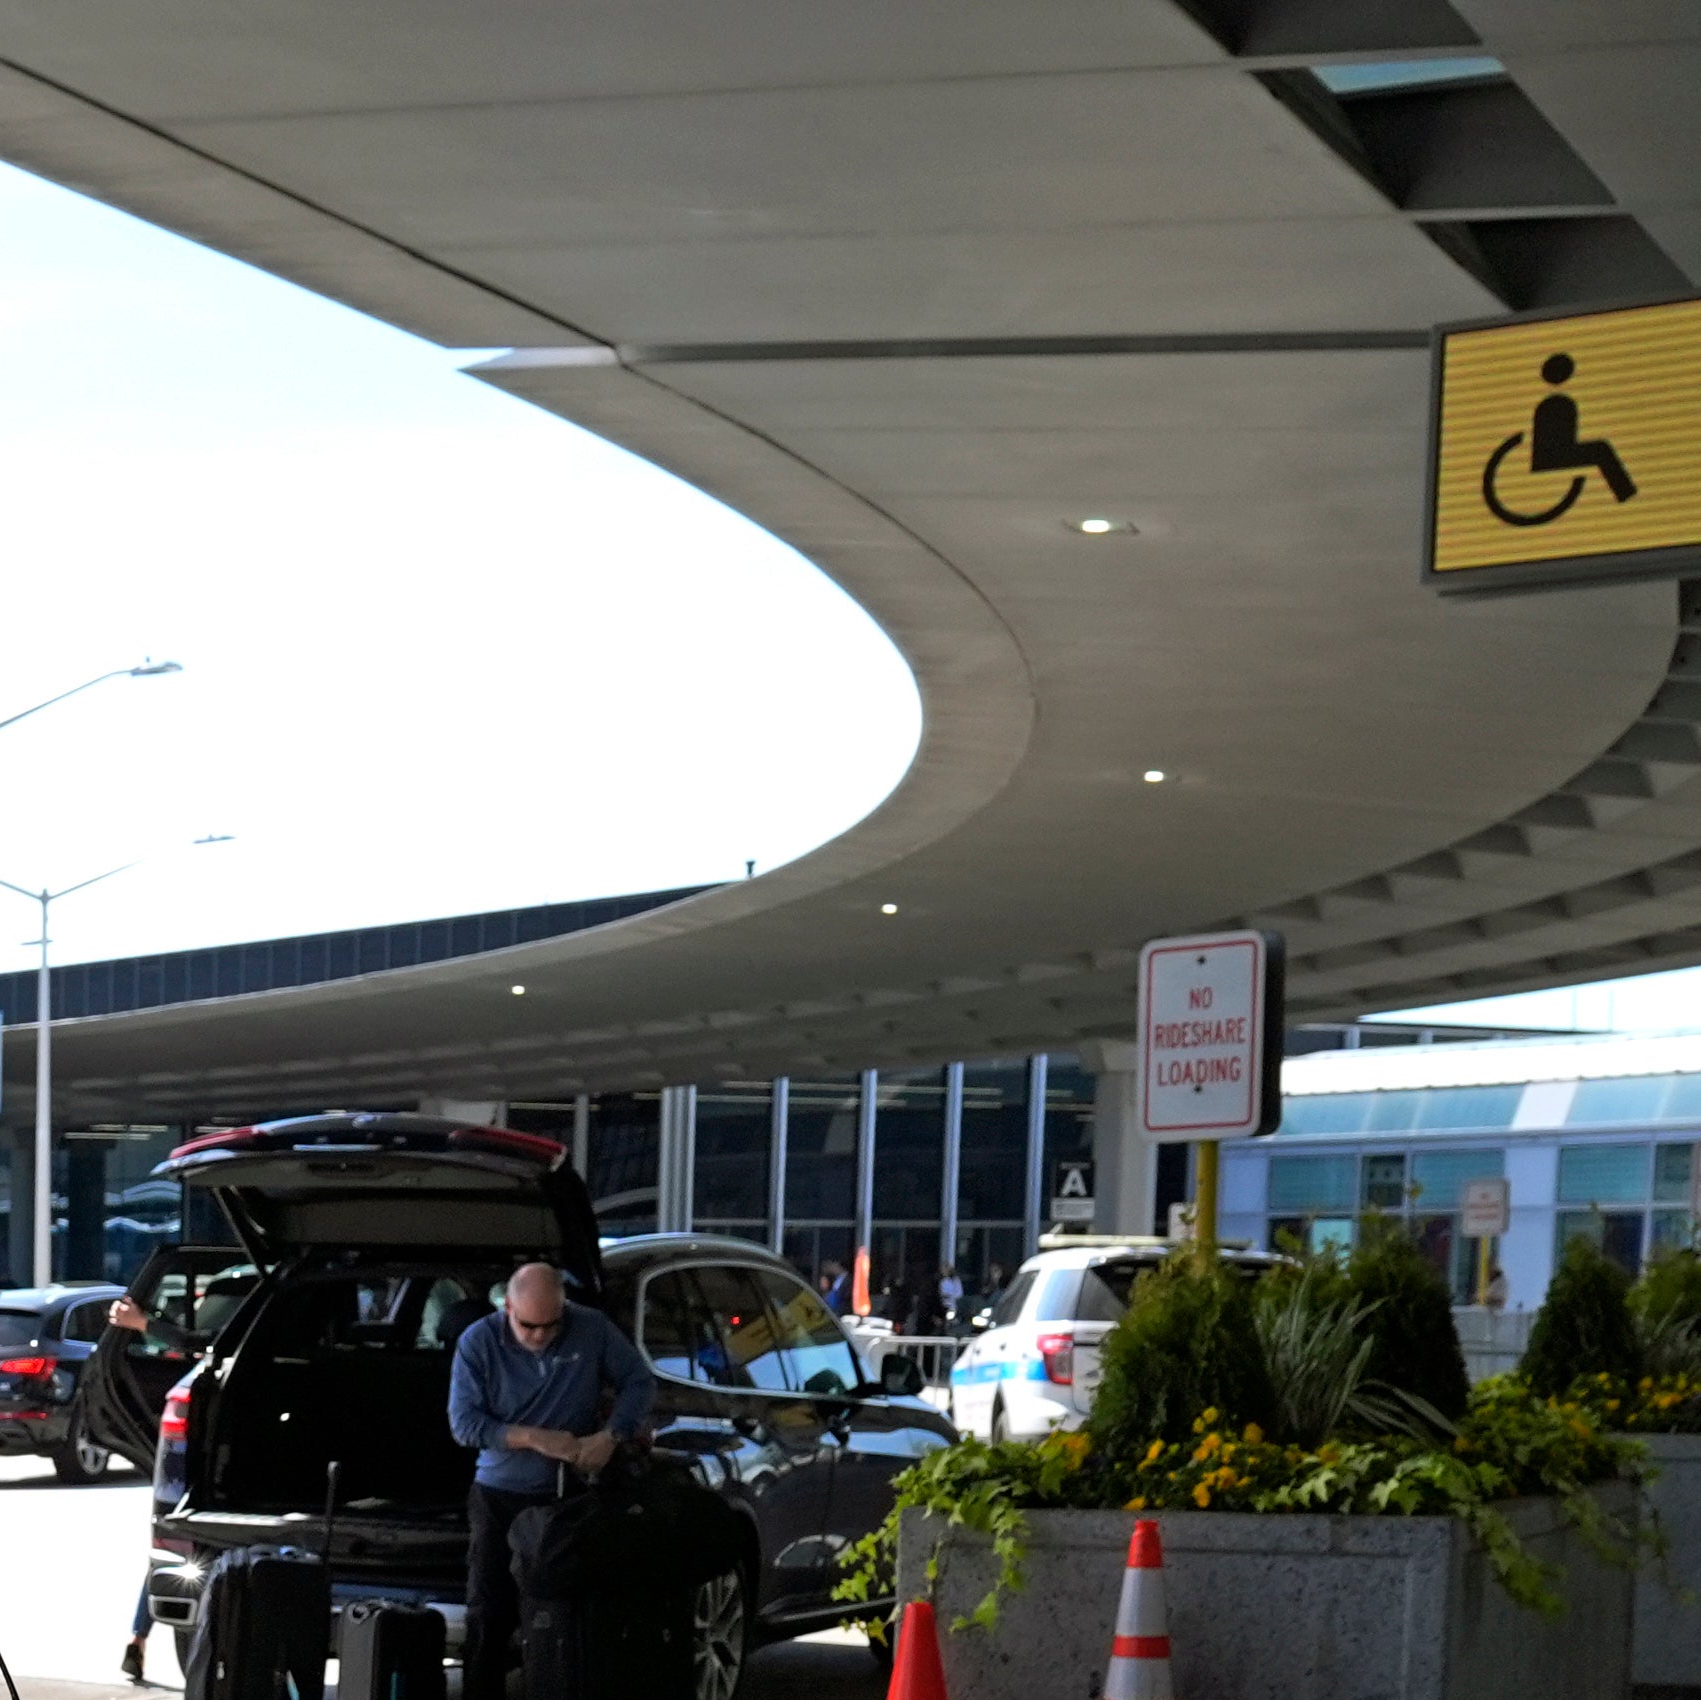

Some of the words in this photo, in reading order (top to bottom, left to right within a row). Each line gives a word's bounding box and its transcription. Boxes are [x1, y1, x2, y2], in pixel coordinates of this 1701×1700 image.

[1189, 986, 1213, 1010] NO
[1154, 1017, 1247, 1048] RIDESHARE
[1157, 1056, 1242, 1087] LOADING
[1061, 1168, 1087, 1197] A
